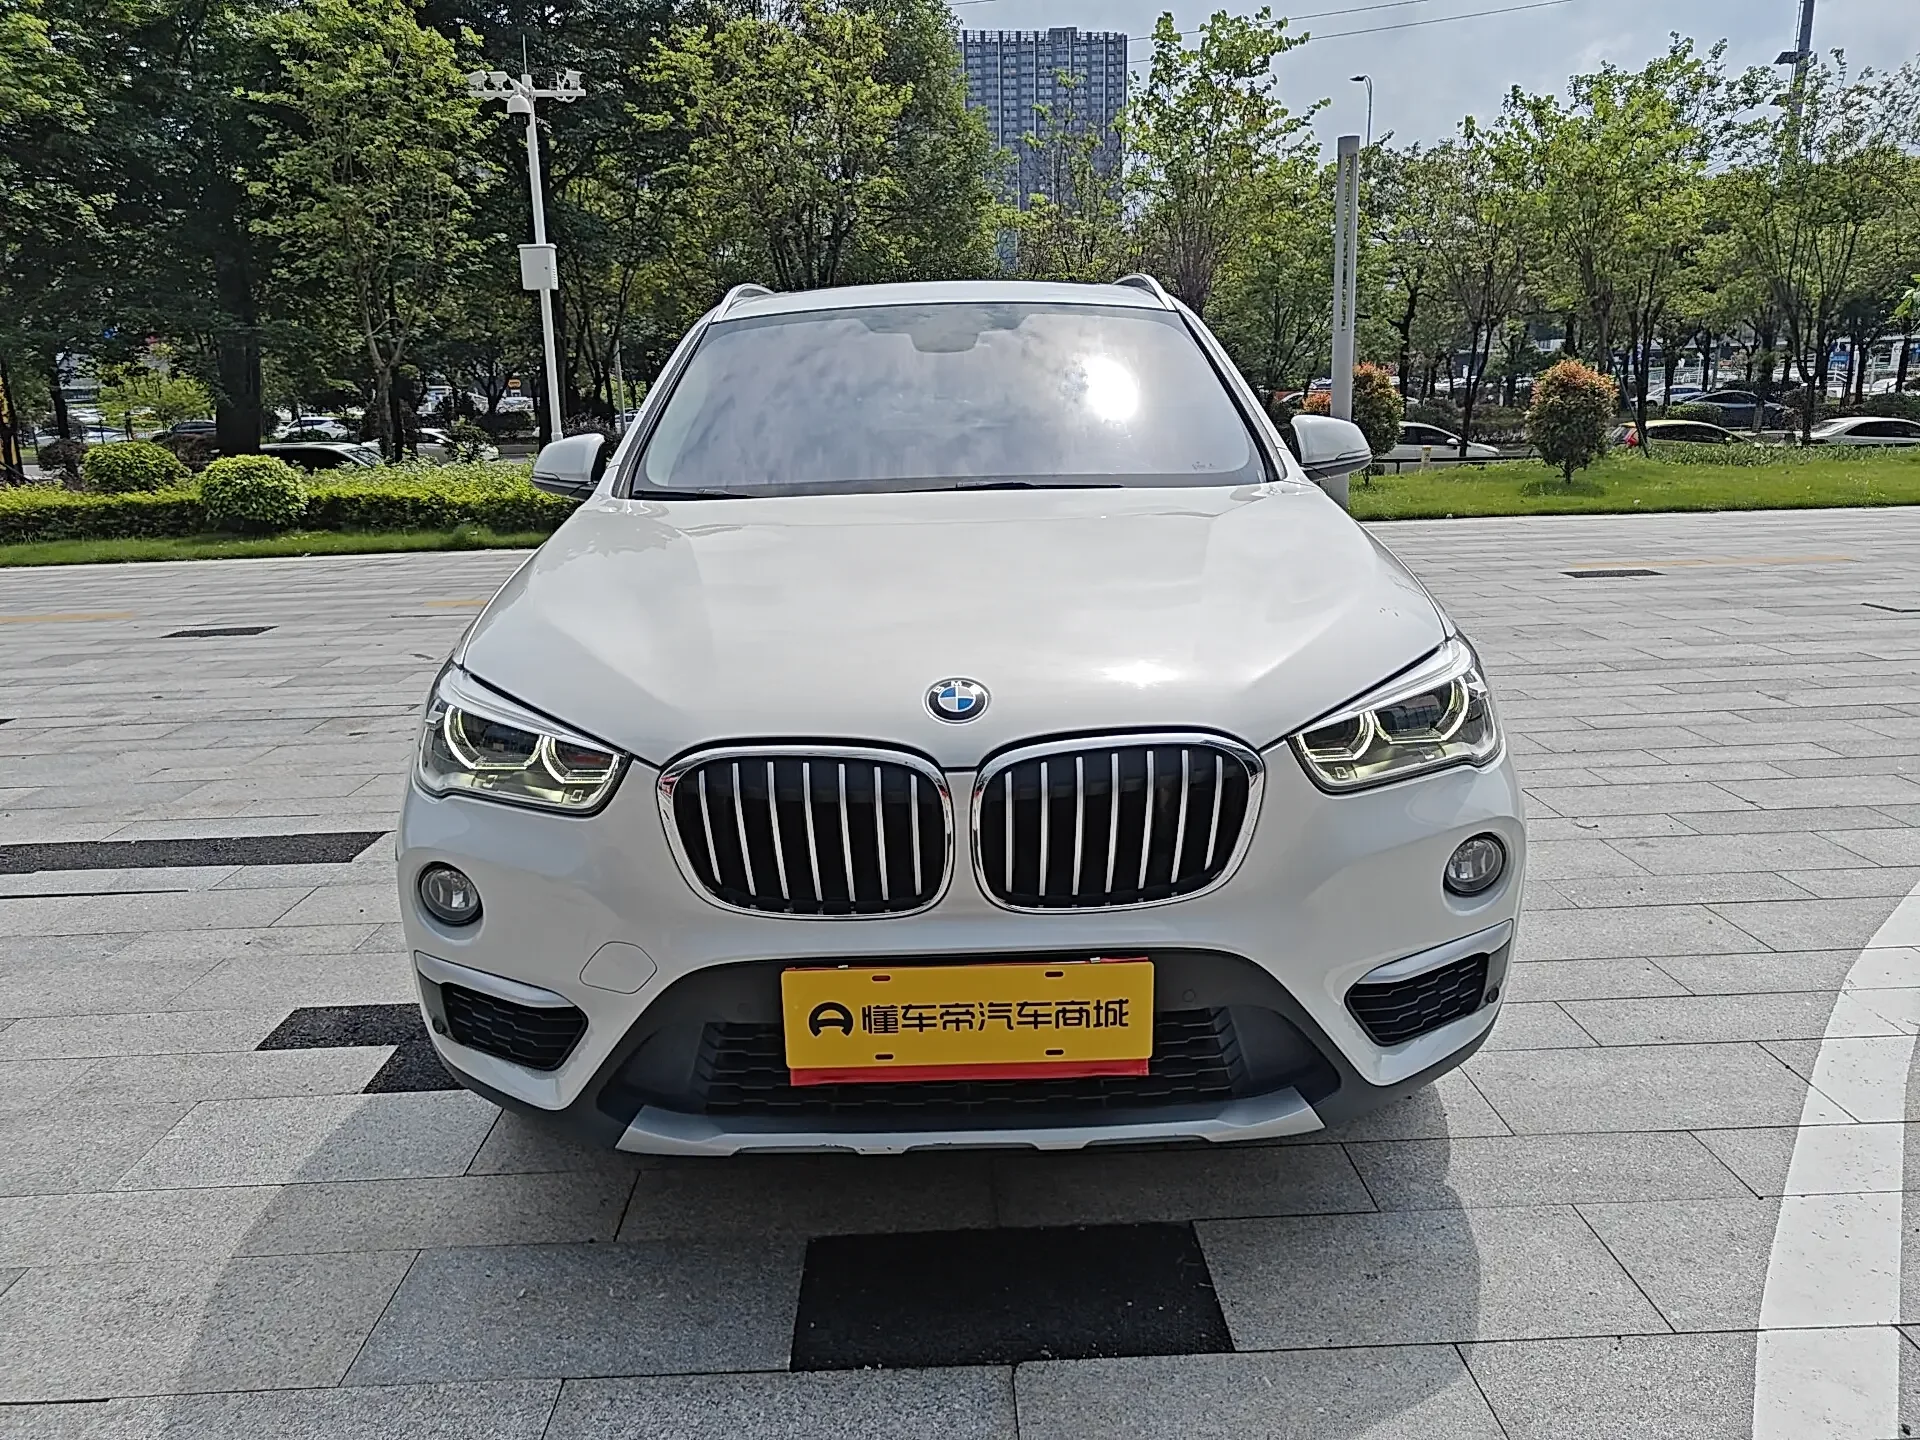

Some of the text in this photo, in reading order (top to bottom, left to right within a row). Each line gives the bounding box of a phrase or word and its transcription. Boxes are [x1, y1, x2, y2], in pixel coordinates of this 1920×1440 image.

[861, 998, 1129, 1035] 懂车帝汽车商城
